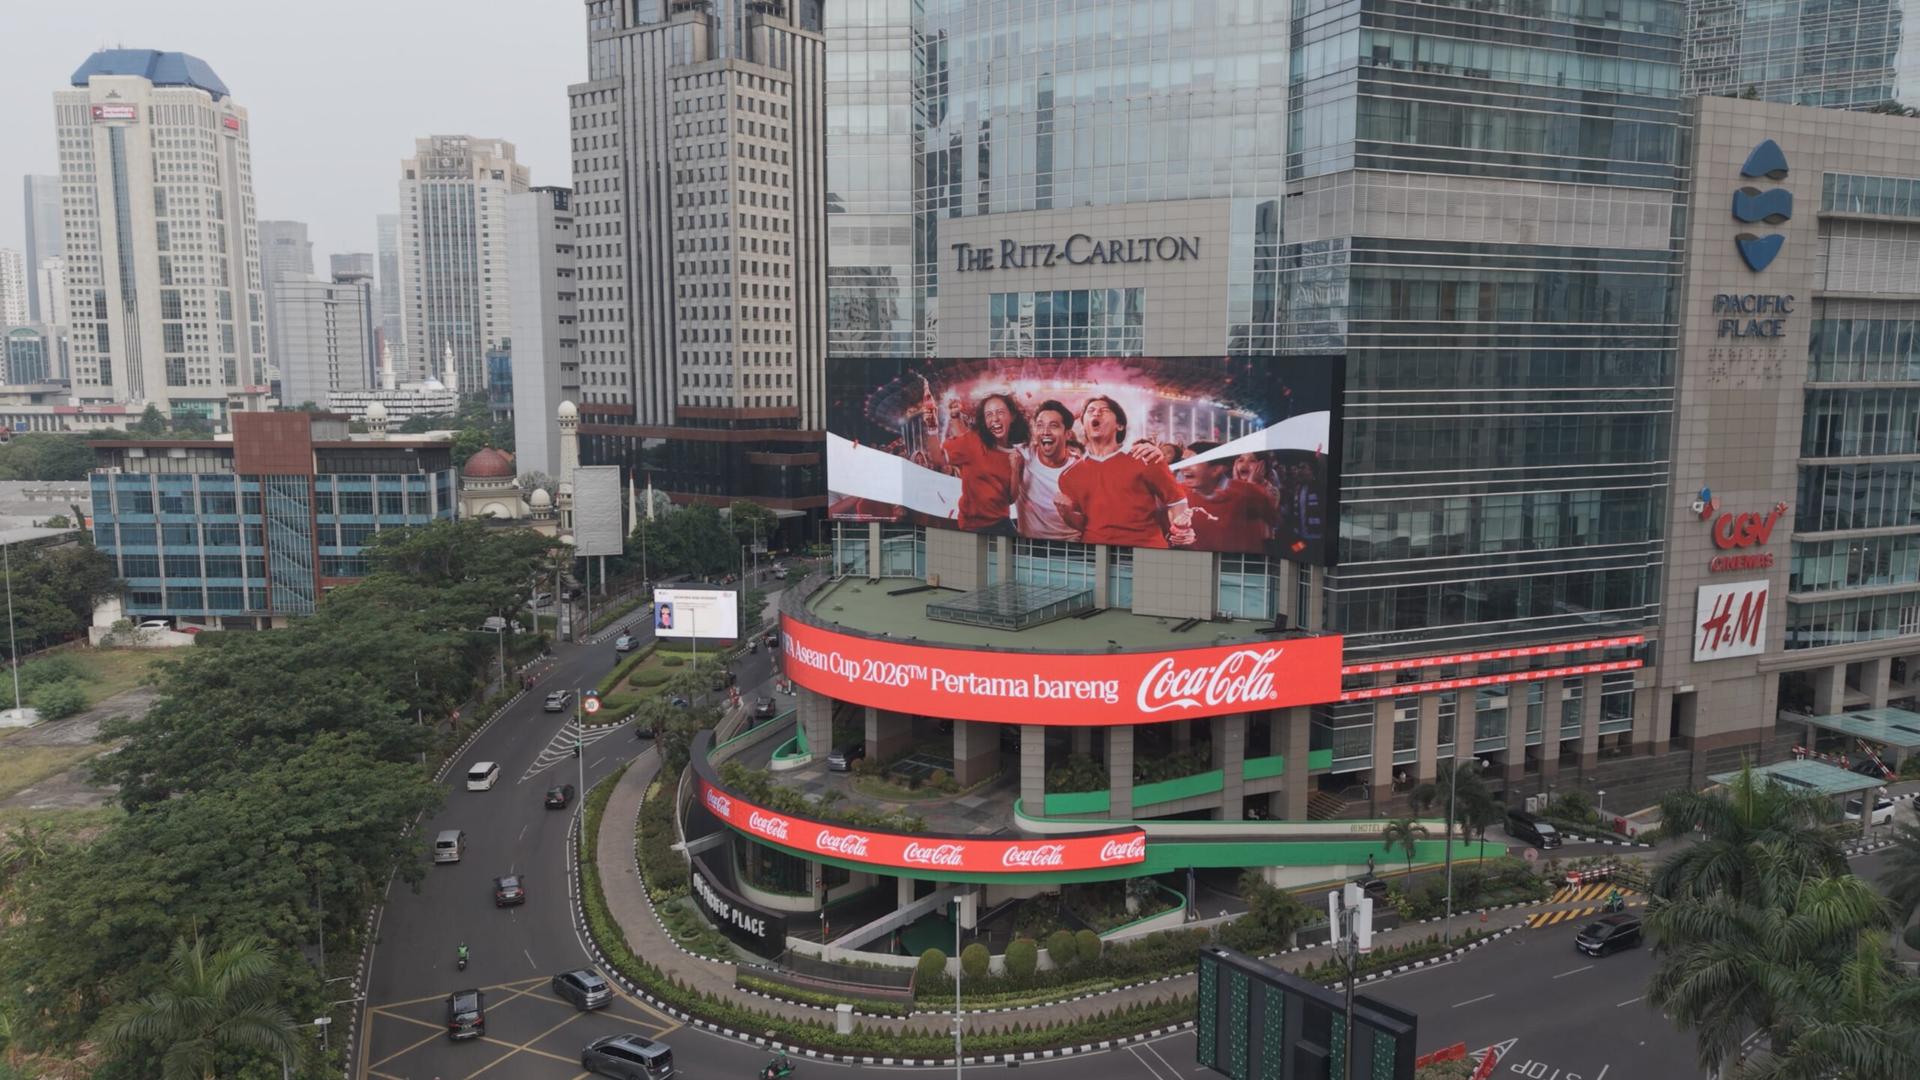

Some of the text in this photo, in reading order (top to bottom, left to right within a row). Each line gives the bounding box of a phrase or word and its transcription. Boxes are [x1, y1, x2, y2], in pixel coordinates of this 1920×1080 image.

[951, 233, 1201, 272] THE RITZ-CARLTON
[1712, 293, 1795, 315] PACIFIC
[1717, 318, 1787, 338] PLACE
[1715, 510, 1782, 549] CGV
[1711, 553, 1775, 573] CINEMAS
[1700, 589, 1768, 651] H&M
[795, 639, 829, 672] Asean
[829, 652, 861, 683] Cup
[930, 667, 1029, 699] Pertama
[1033, 673, 1119, 704] bareng
[749, 811, 788, 840] Coca-Cola
[816, 829, 870, 858] Coca-Cola
[903, 841, 966, 866] Coca-Cola
[1002, 844, 1066, 867] Coca-Cola
[704, 886, 729, 919] PACIFIC
[732, 909, 765, 937] PLACE
